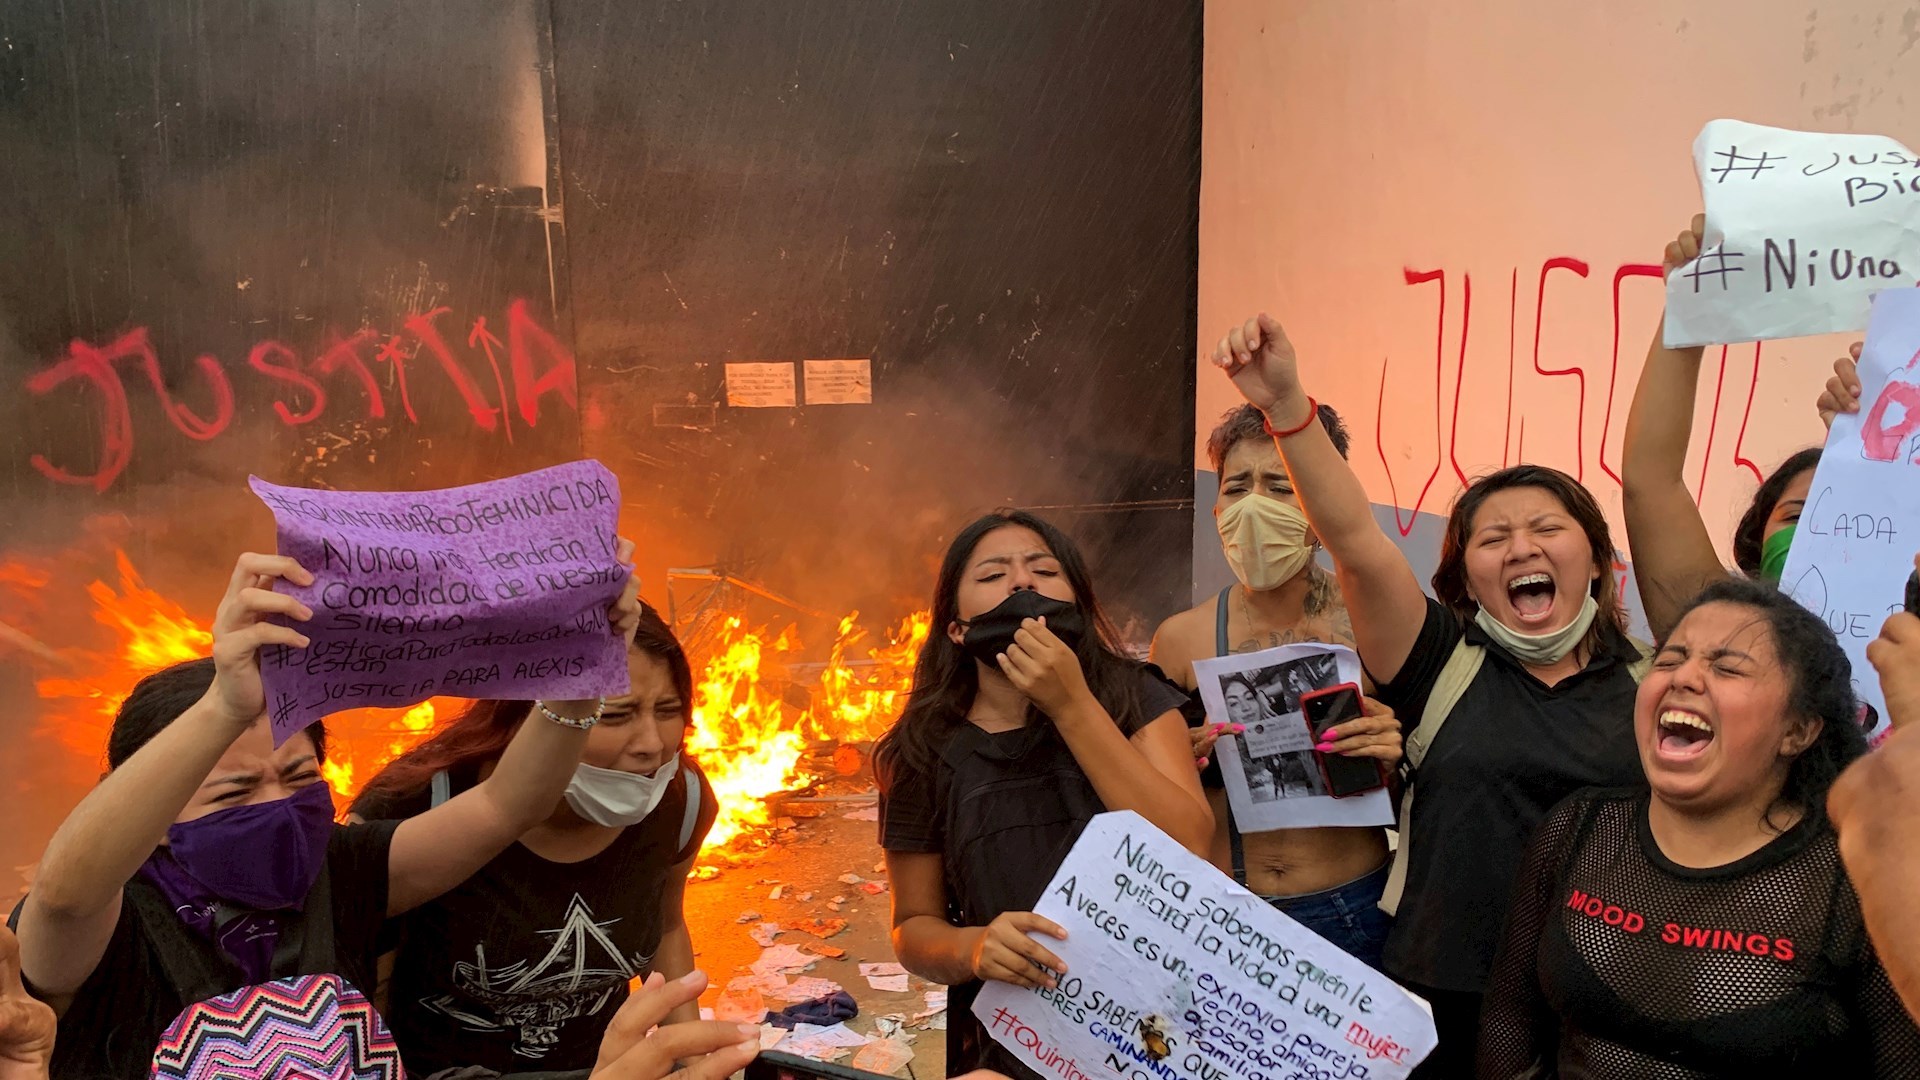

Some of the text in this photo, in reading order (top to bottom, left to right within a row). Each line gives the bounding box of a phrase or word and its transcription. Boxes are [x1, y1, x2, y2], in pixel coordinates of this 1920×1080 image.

[1809, 486, 1898, 545] CADA
[322, 532, 420, 575] Nunca
[495, 574, 526, 600] de
[442, 664, 501, 685] PARA
[513, 656, 585, 680] ALEXIS
[1113, 833, 1192, 904] Nunca
[1348, 982, 1375, 1014] le
[1133, 936, 1160, 961] es
[1566, 889, 1795, 961] MOOD SWINGS
[1114, 873, 1411, 1063] quitará la vida a una mujer
